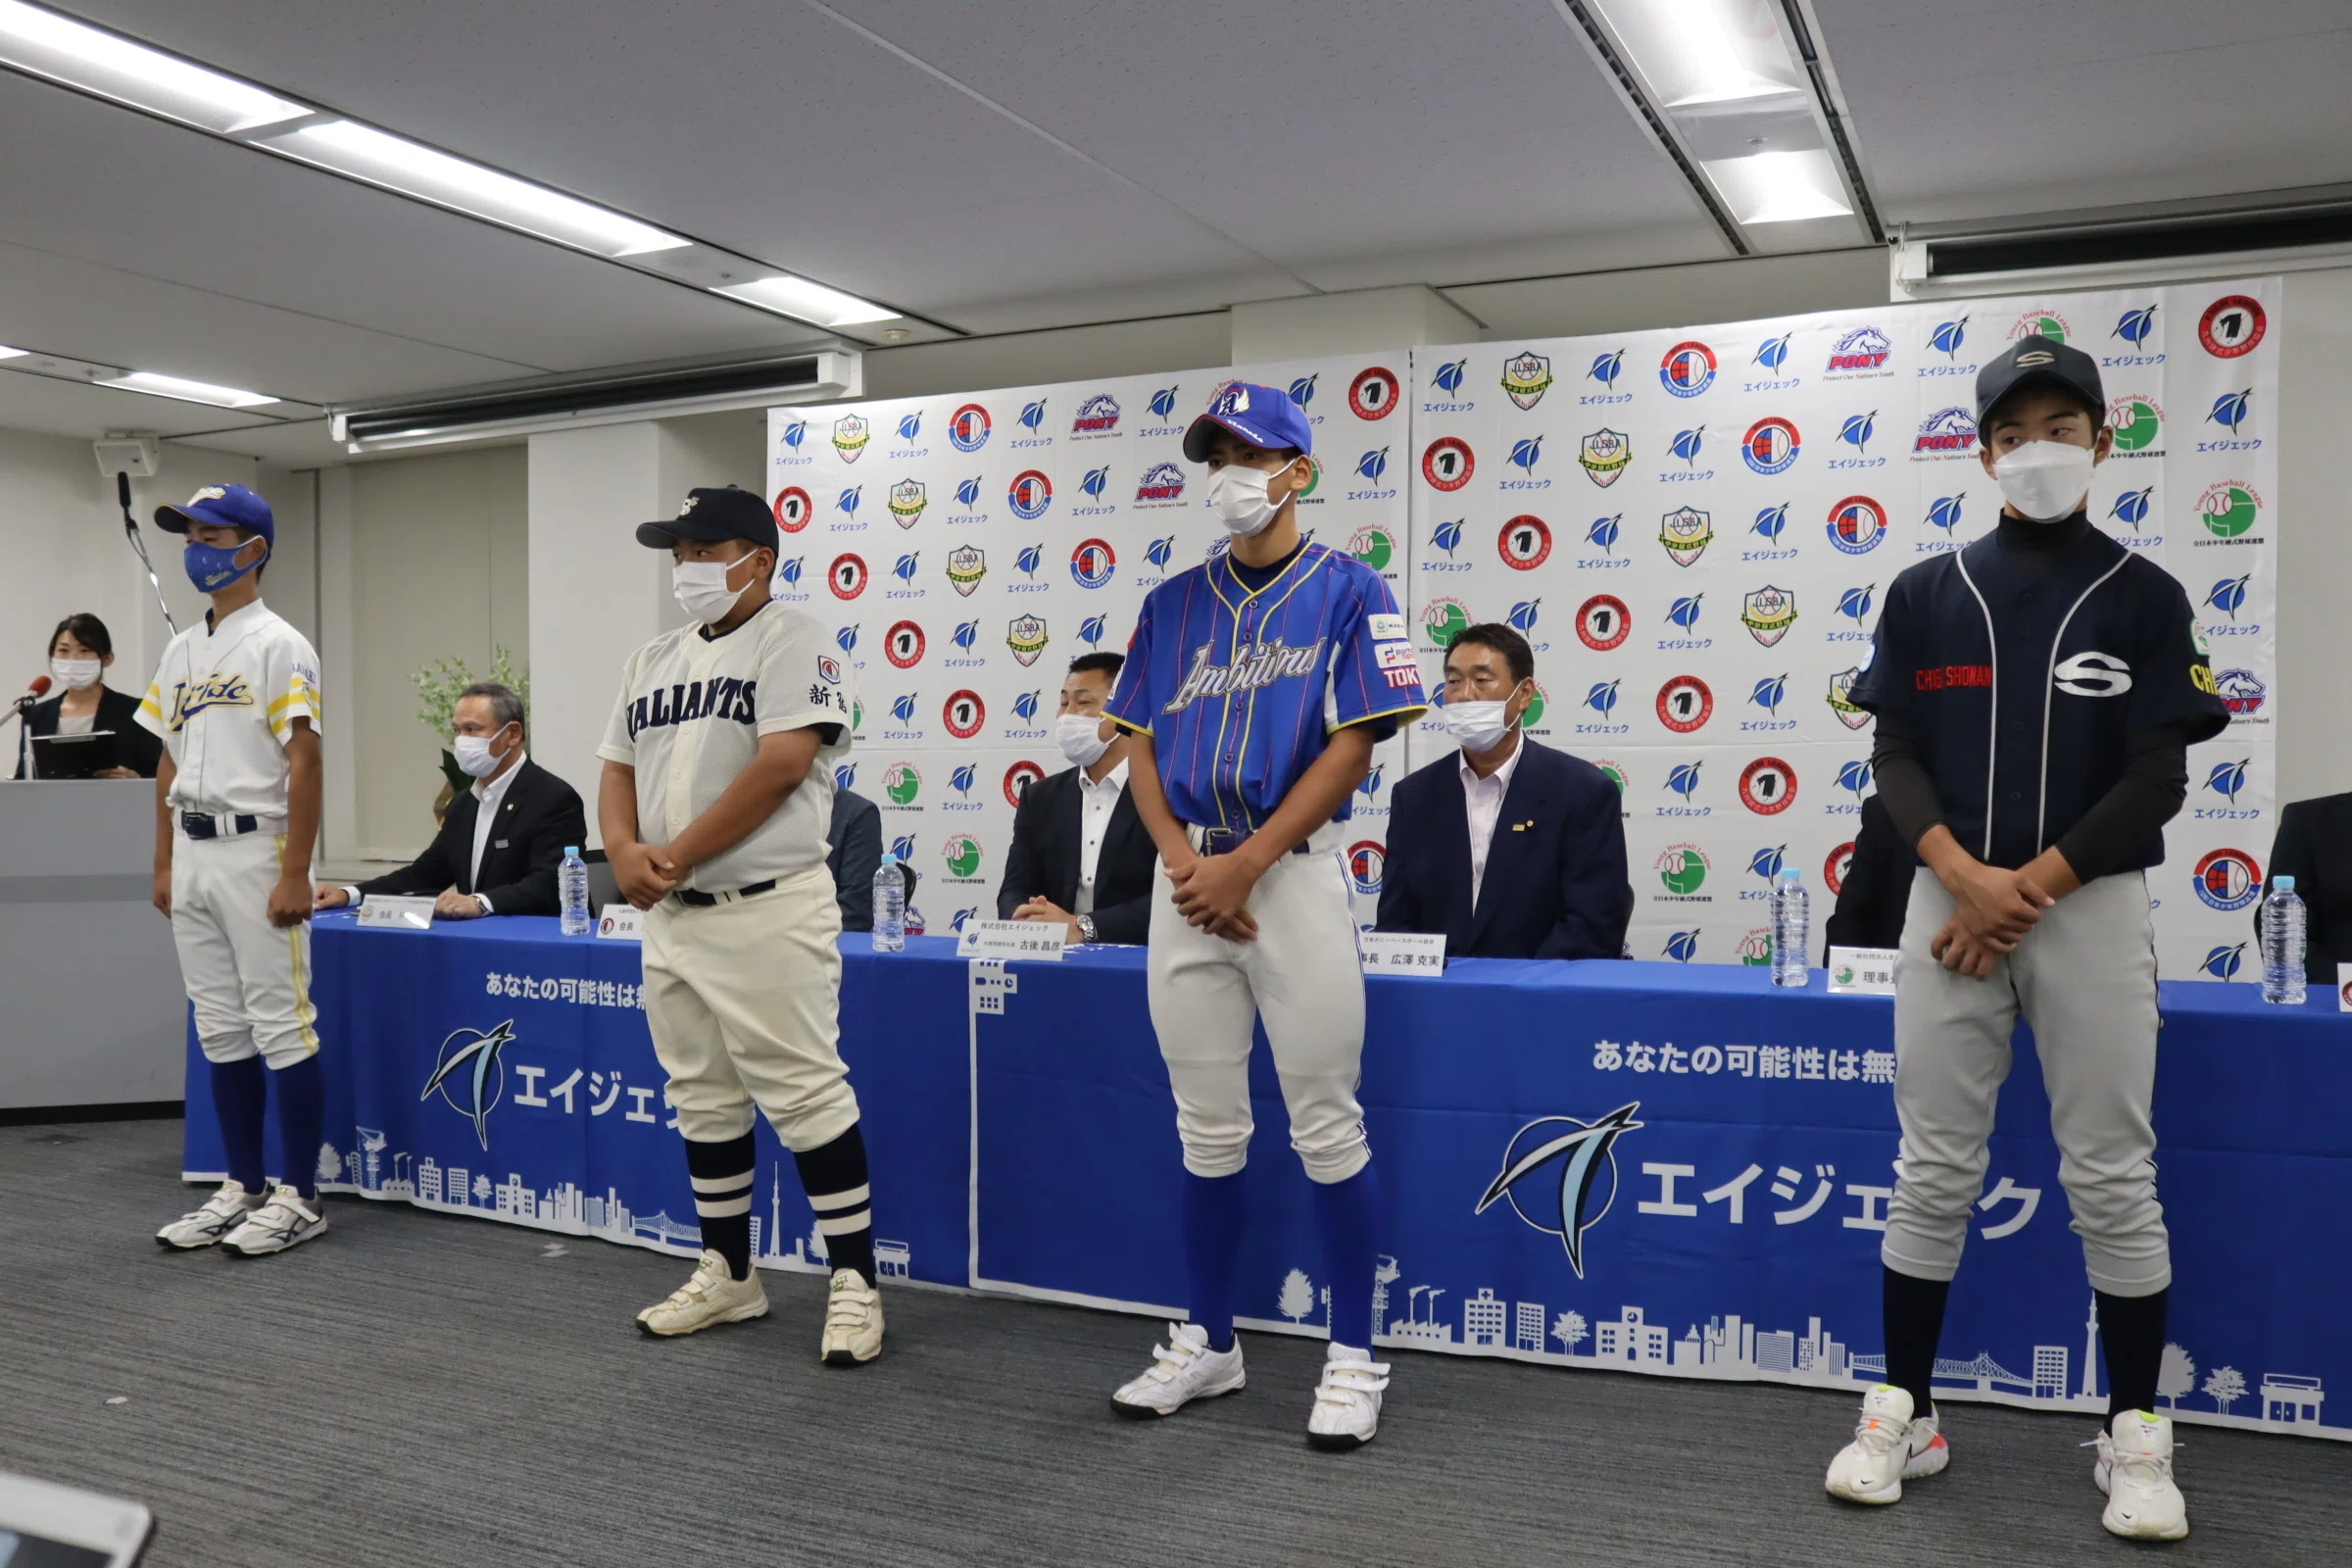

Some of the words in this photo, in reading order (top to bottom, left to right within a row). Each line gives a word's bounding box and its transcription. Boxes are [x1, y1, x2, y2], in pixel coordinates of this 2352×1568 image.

[2006, 317, 2023, 341] Young
[2023, 310, 2054, 319] Baseball
[1826, 353, 1890, 372] PONY
[2102, 353, 2166, 367] エイジェック
[1918, 365, 1977, 376] エイジェック
[1744, 378, 1799, 392] エイジェック
[1580, 394, 1633, 405] エイジェック
[2113, 394, 2148, 407] Baseball
[1424, 402, 1474, 412] エイジェック
[1072, 416, 1119, 432] PONY
[1912, 434, 1979, 453] PONY
[2197, 439, 2262, 452] エイジェック
[1829, 457, 1886, 468] エイジェック
[1659, 470, 1714, 482] エイジェック
[1499, 479, 1551, 489] エイジェック
[1135, 485, 1185, 502] PONY
[1348, 490, 1396, 500] エイジェック
[2193, 490, 2211, 512] Young
[2210, 479, 2244, 490] Baseball
[2245, 484, 2263, 510] League
[2116, 536, 2163, 547] ジェック
[1741, 549, 1797, 561] エイジェック
[1422, 562, 1472, 571] エイジェック
[1578, 559, 1630, 568] エイジェック
[1137, 576, 1166, 586] エイジェ
[1431, 596, 1458, 606] Baseball
[2206, 624, 2260, 635] イジェック
[1827, 631, 1874, 641] エイジェッ
[1657, 639, 1712, 649] エイジェック
[1162, 637, 1327, 714] Ambitious
[1384, 668, 1420, 688] TOK
[1576, 724, 1629, 733] エイジェック
[1740, 720, 1796, 730] エイジェック
[1351, 806, 1391, 815] イジェック
[1656, 807, 1711, 815] エイジェック
[1826, 805, 1863, 814] エイジェ
[2195, 808, 2259, 819] エイジェック
[1668, 843, 1697, 856] Baseball
[981, 921, 1049, 931] 株式会社エイジェック
[1749, 927, 1772, 937] Baseb
[514, 1064, 678, 1129] エイジェ
[1638, 1162, 2041, 1240] エイジェク
